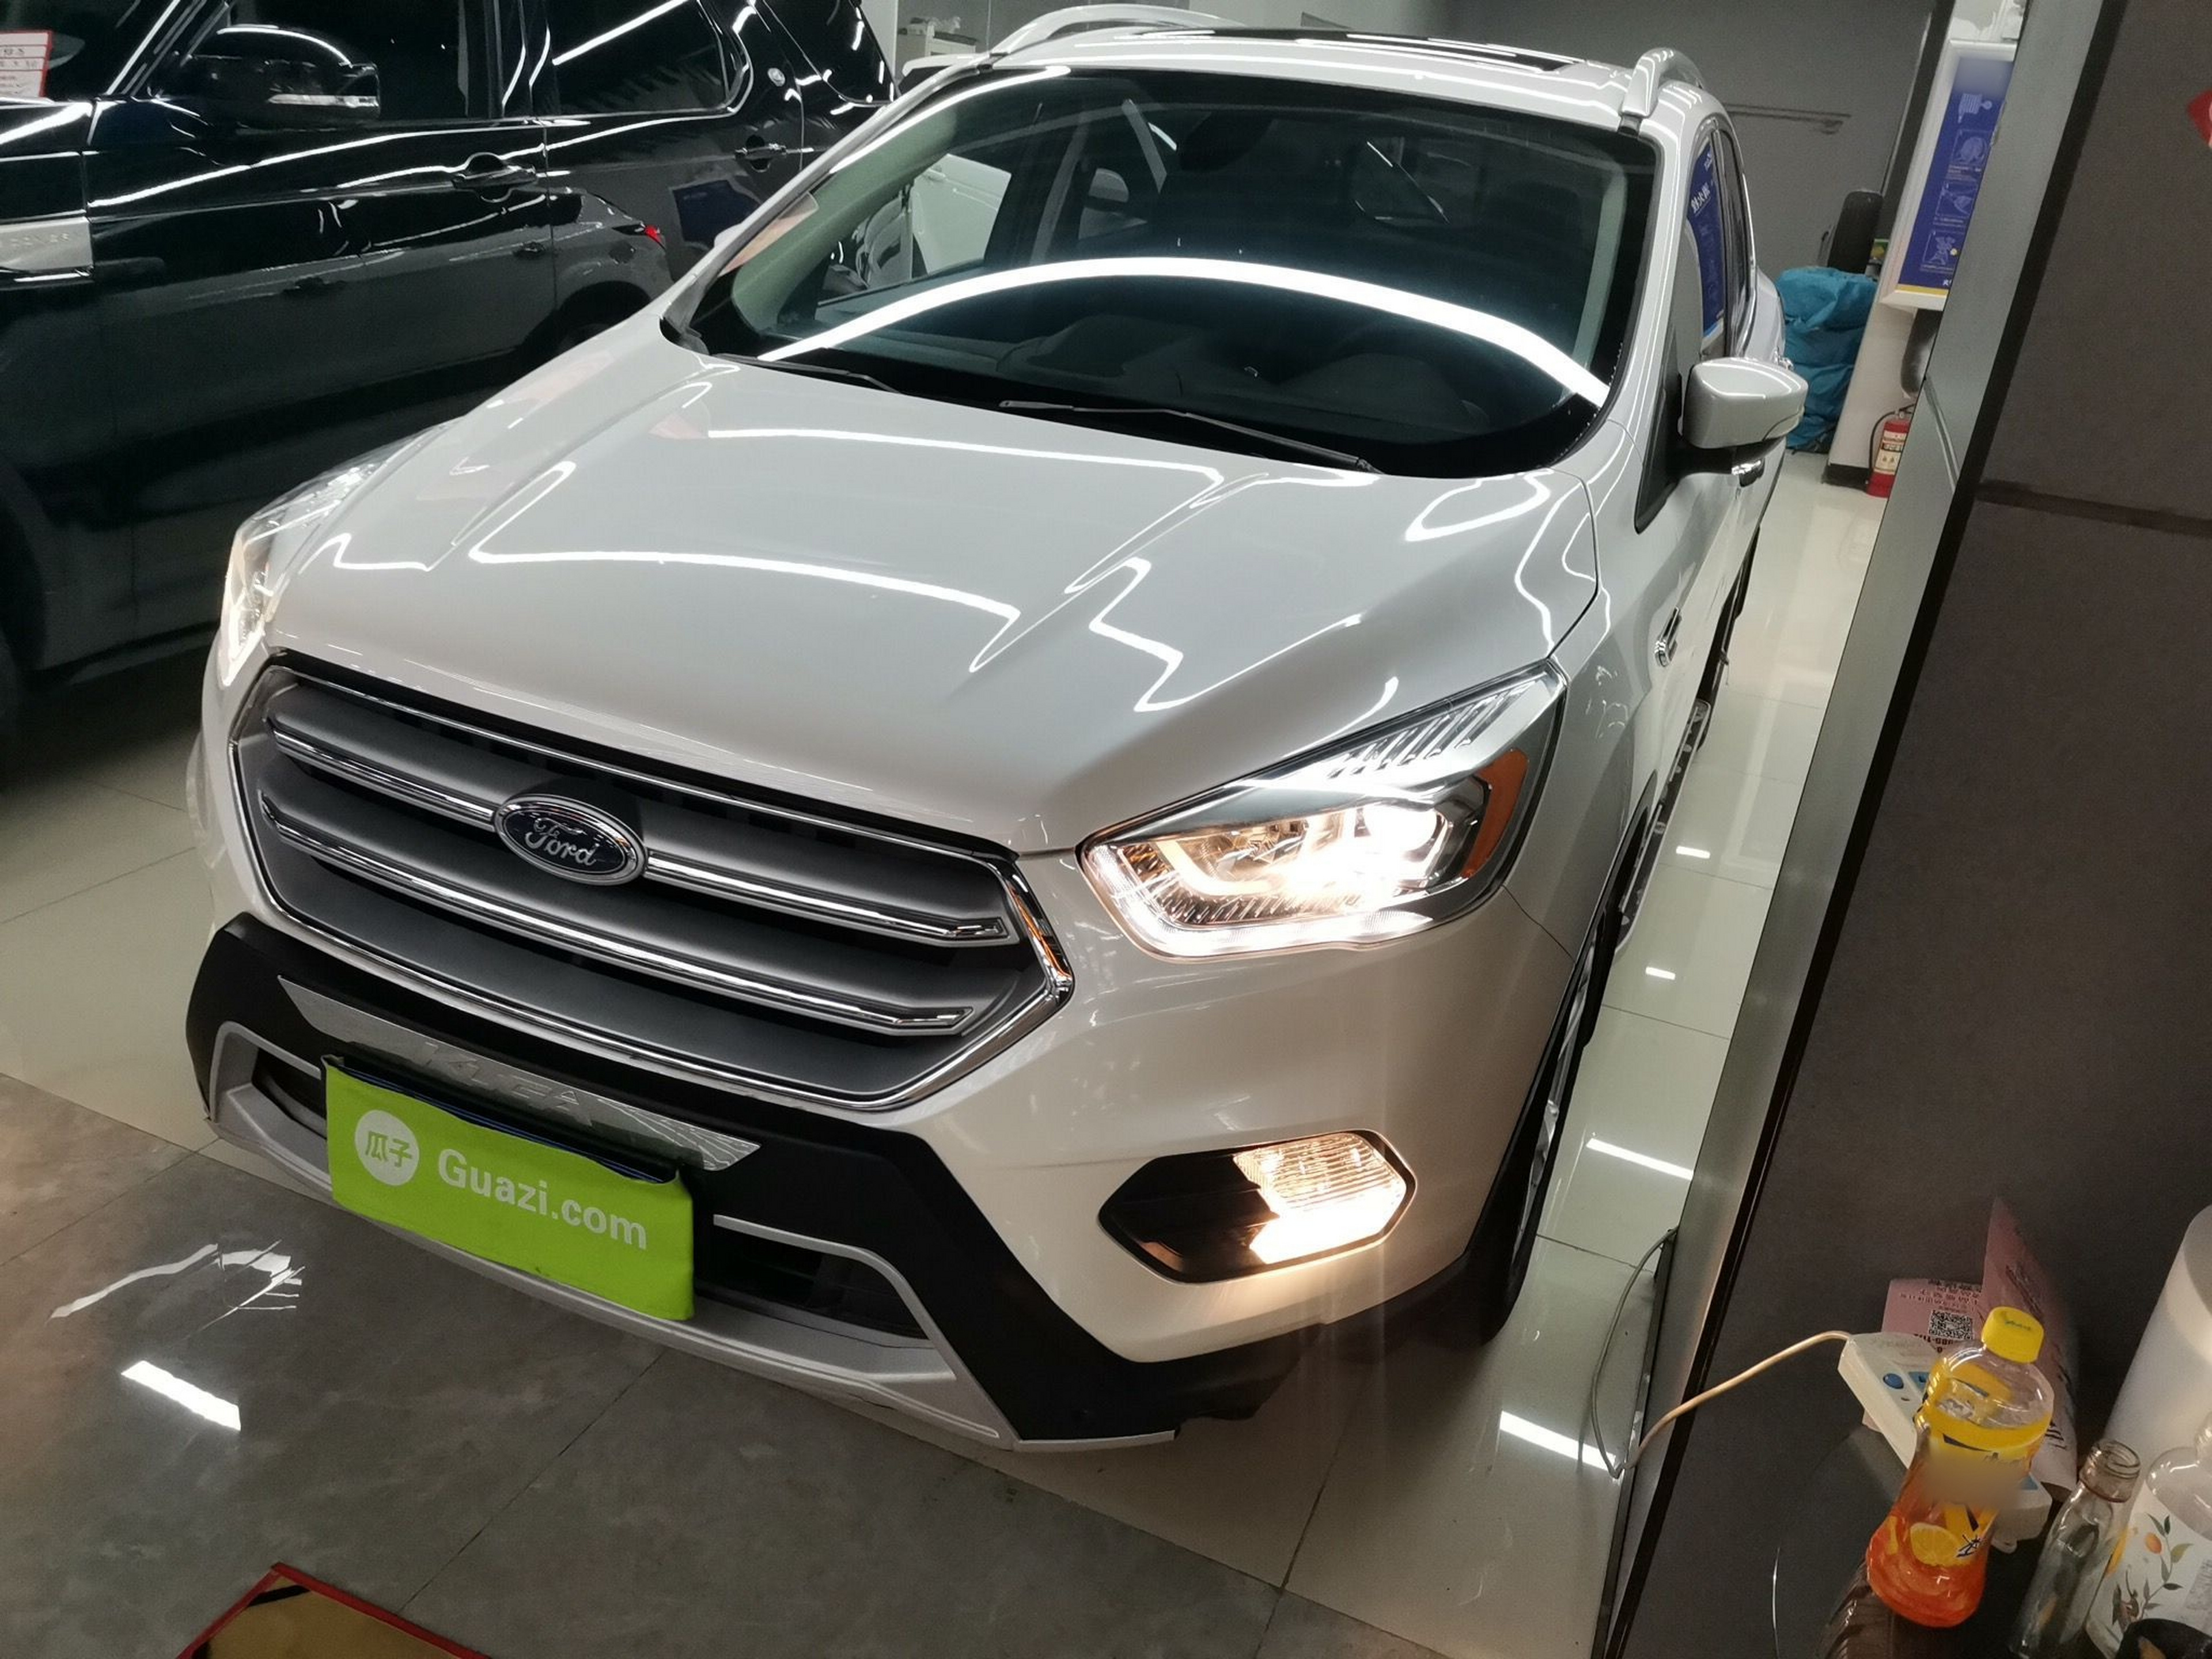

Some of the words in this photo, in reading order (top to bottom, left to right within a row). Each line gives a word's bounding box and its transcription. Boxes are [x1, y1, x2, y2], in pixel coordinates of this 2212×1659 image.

[525, 816, 600, 866] Ford
[365, 1130, 413, 1168] 瓜子
[437, 1148, 647, 1250] Guazi.com
